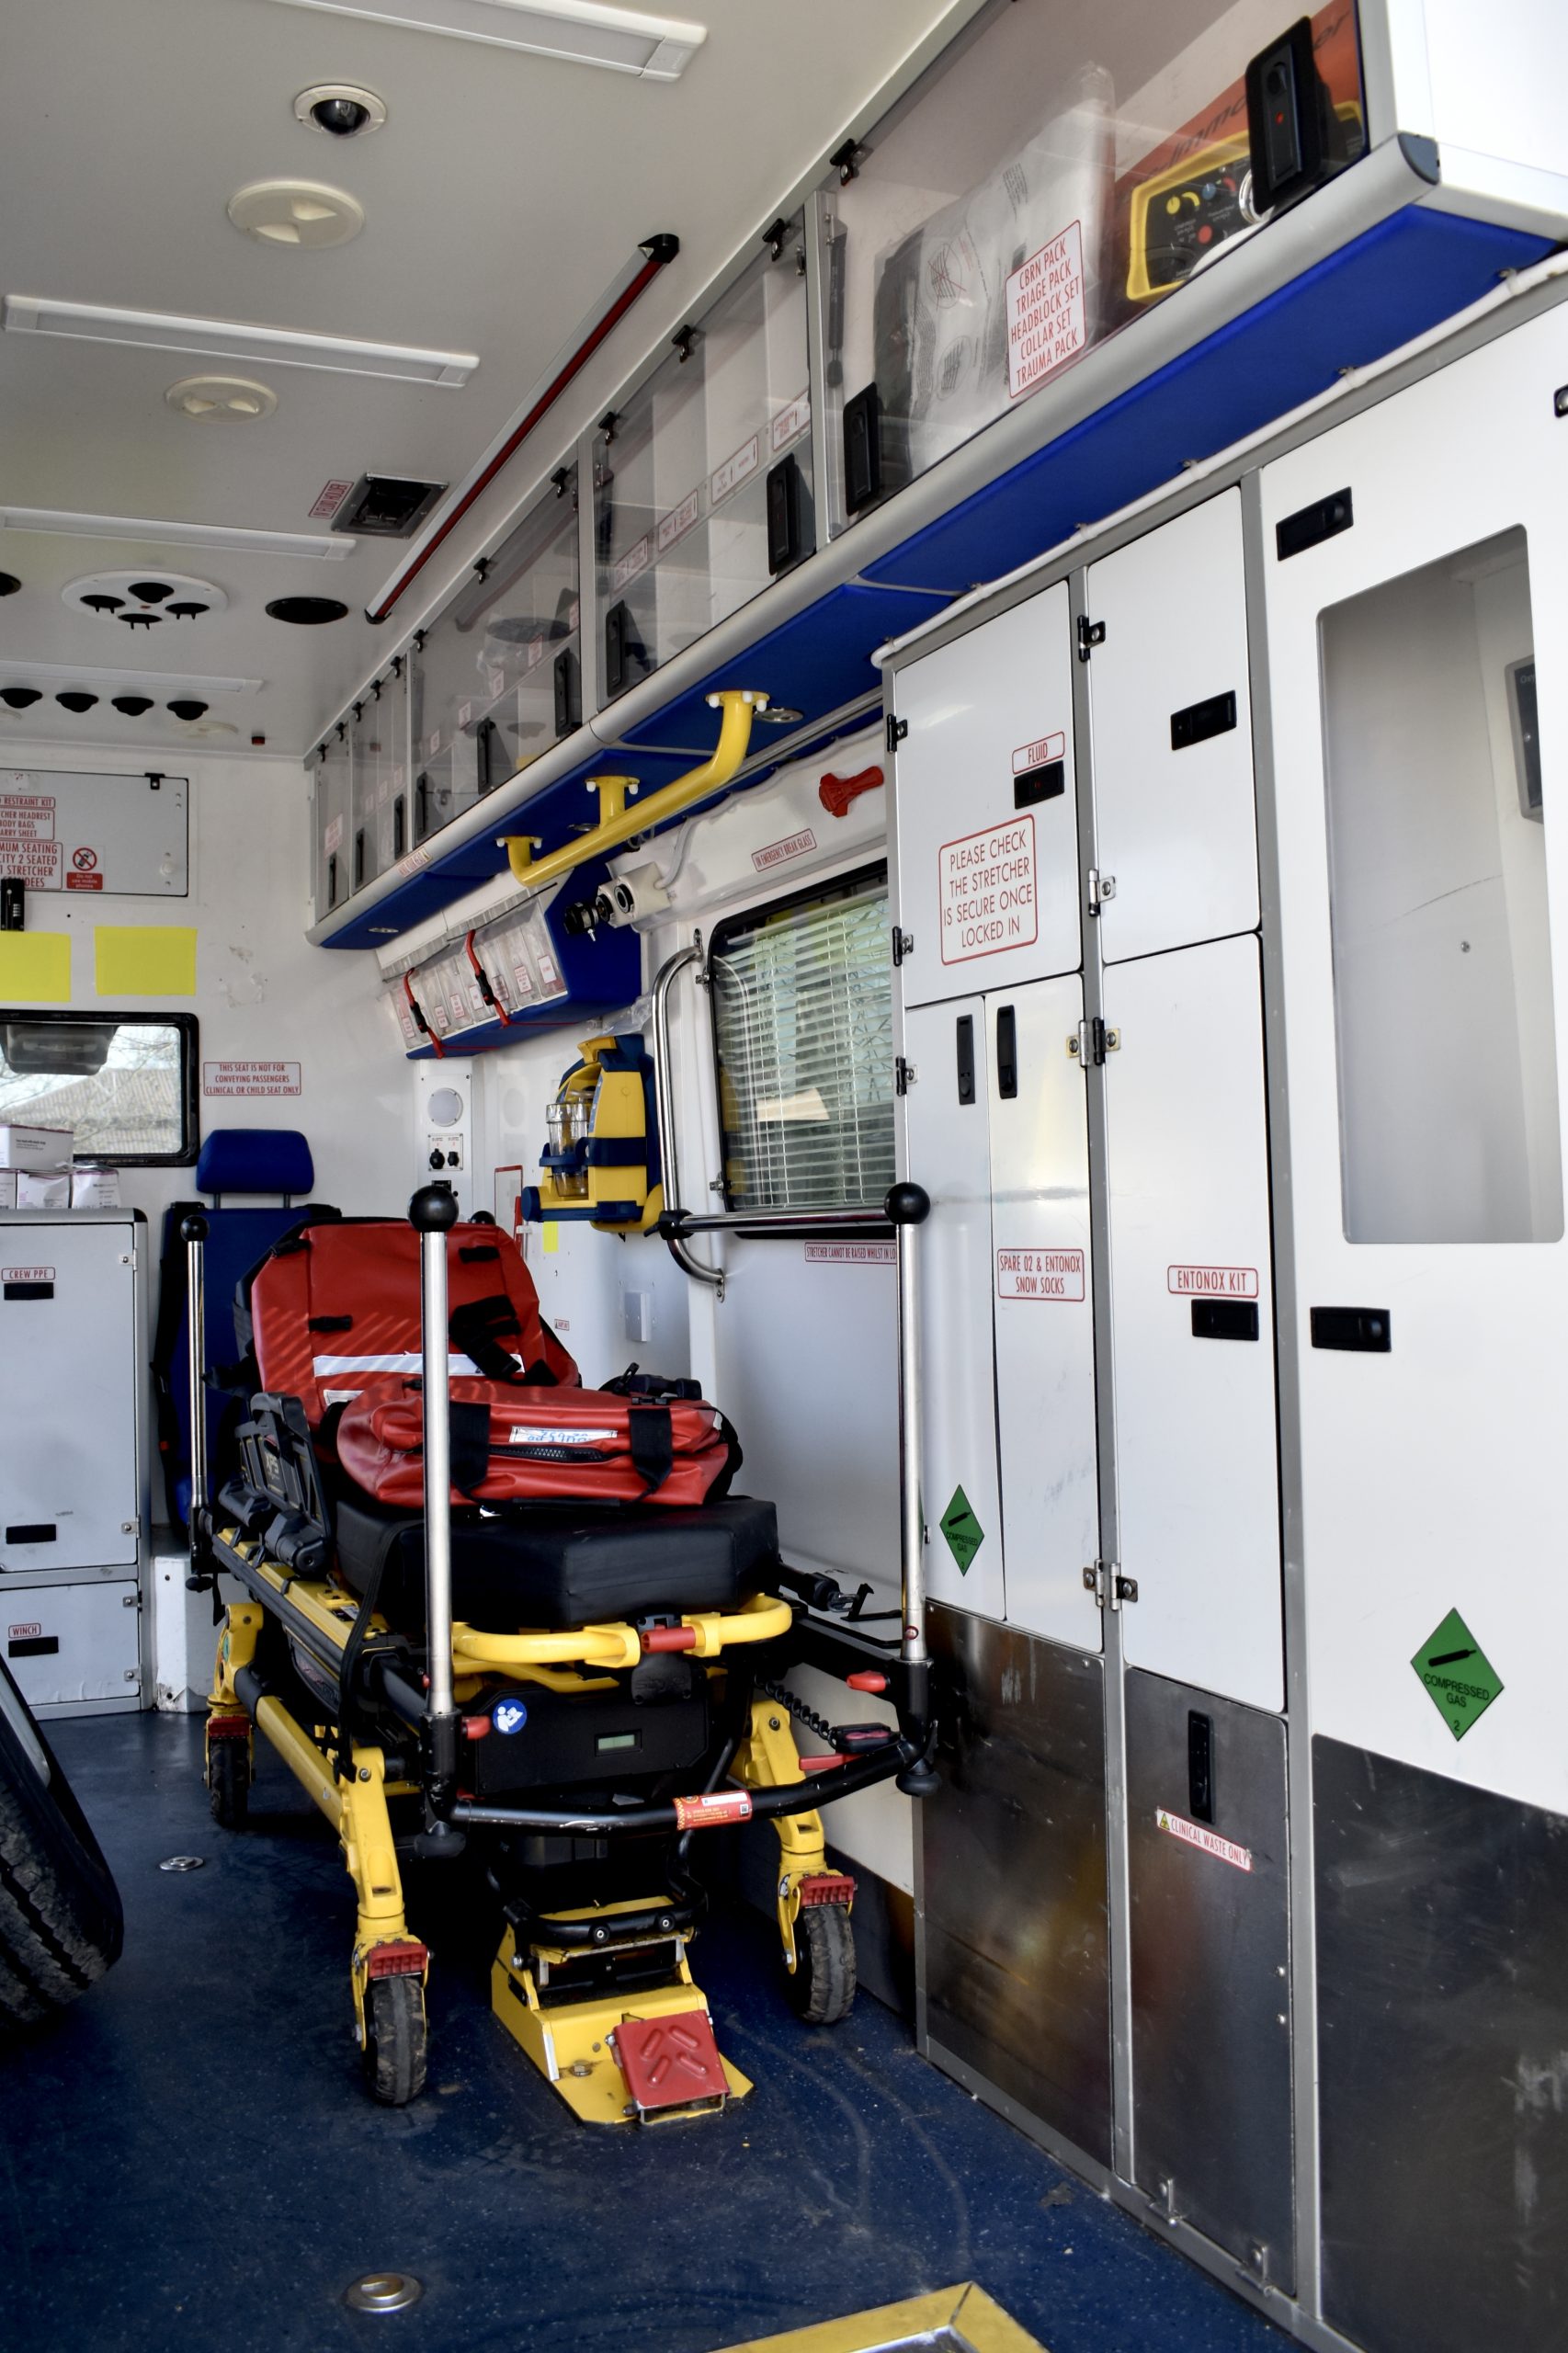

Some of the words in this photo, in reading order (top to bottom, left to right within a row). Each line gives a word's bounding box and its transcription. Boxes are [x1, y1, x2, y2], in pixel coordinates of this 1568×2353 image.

[1019, 260, 1041, 290] CBRN
[1044, 237, 1066, 268] PACK
[1017, 282, 1046, 316] TRIAGE
[1050, 258, 1072, 290] PACK
[1011, 292, 1062, 345] HEADBLOCK
[1064, 276, 1080, 303] SET
[1020, 324, 1053, 360] COLLAR
[1057, 307, 1072, 335] SET
[1017, 349, 1052, 387] TRAUMA
[1055, 327, 1077, 357] PACK
[1028, 742, 1048, 765] FLUID
[4, 797, 38, 806] RESTRAINT
[41, 798, 52, 807] KIT
[18, 811, 51, 821] HEADREST
[18, 830, 37, 838] SHEET
[21, 843, 58, 854] SEATING
[761, 846, 784, 865] EMERGENCY
[783, 839, 798, 856] BREAK
[797, 834, 812, 850] GLASS
[950, 844, 985, 872] PLEASE
[990, 829, 1027, 858] CHECK
[18, 854, 24, 864] 2
[27, 855, 57, 865] SEATED
[7, 865, 53, 877] STRETCHER
[949, 876, 968, 899] THE
[972, 857, 1029, 892] STRETCHER
[944, 907, 952, 926] IS
[957, 894, 994, 923] SECURE
[999, 883, 1032, 910] ONCE
[961, 920, 1004, 949] LOCKED
[1008, 915, 1020, 936] IN
[220, 1063, 233, 1073] THIS
[234, 1063, 249, 1073] SEAT
[251, 1063, 257, 1073] IS
[258, 1063, 271, 1073] NOT
[272, 1063, 286, 1073] FOR
[215, 1074, 251, 1083] CONVEYING
[252, 1074, 290, 1083] PASSENGERS
[206, 1086, 234, 1095] CLINICAL
[236, 1086, 244, 1095] OR
[246, 1086, 266, 1095] CHILD
[267, 1086, 281, 1095] SEAT
[282, 1086, 300, 1095] ONLY
[807, 1246, 827, 1257] STRETCHER
[829, 1246, 845, 1258] CANNOT
[846, 1247, 851, 1258] BE
[851, 1247, 866, 1258] RAISED
[867, 1248, 882, 1259] WHILST
[883, 1248, 890, 1259] IN
[1000, 1256, 1021, 1272] SPARE
[1036, 1256, 1042, 1272] &
[1045, 1256, 1081, 1272] ENTONOX
[9, 1269, 30, 1279] CREW
[33, 1269, 48, 1279] PPE
[1177, 1270, 1225, 1290] ENTONOX
[1229, 1272, 1246, 1291] KIT
[1016, 1277, 1038, 1293] SNOW
[1040, 1277, 1065, 1294] SOCKS
[13, 1625, 37, 1636] WINCH
[1424, 1673, 1489, 1701] COMPRESSED
[1446, 1692, 1467, 1708] GAS
[1453, 1720, 1460, 1732] 2
[1171, 1818, 1201, 1844] CLINICAL
[1204, 1834, 1226, 1856] WASTE
[1229, 1845, 1248, 1866] ONLY
